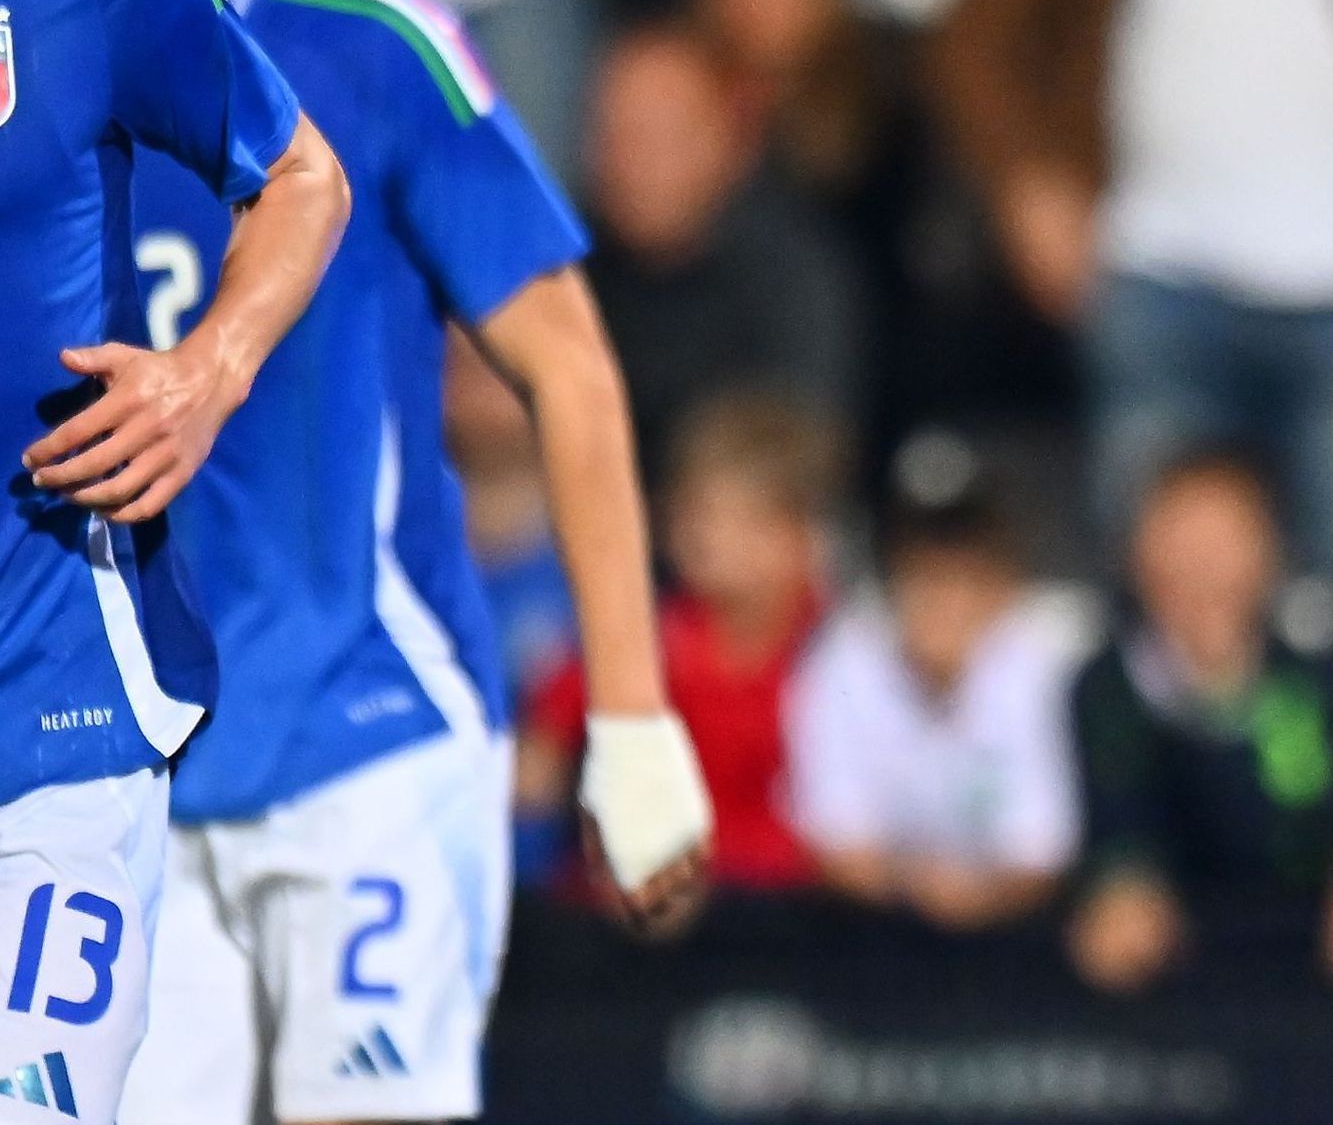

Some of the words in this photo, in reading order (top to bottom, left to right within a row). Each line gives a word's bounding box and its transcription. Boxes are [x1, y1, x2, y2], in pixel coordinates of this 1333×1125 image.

[134, 232, 203, 350] 2
[41, 708, 113, 731] HEAT.RDY
[8, 883, 123, 1025] 13
[340, 876, 403, 1002] 2
